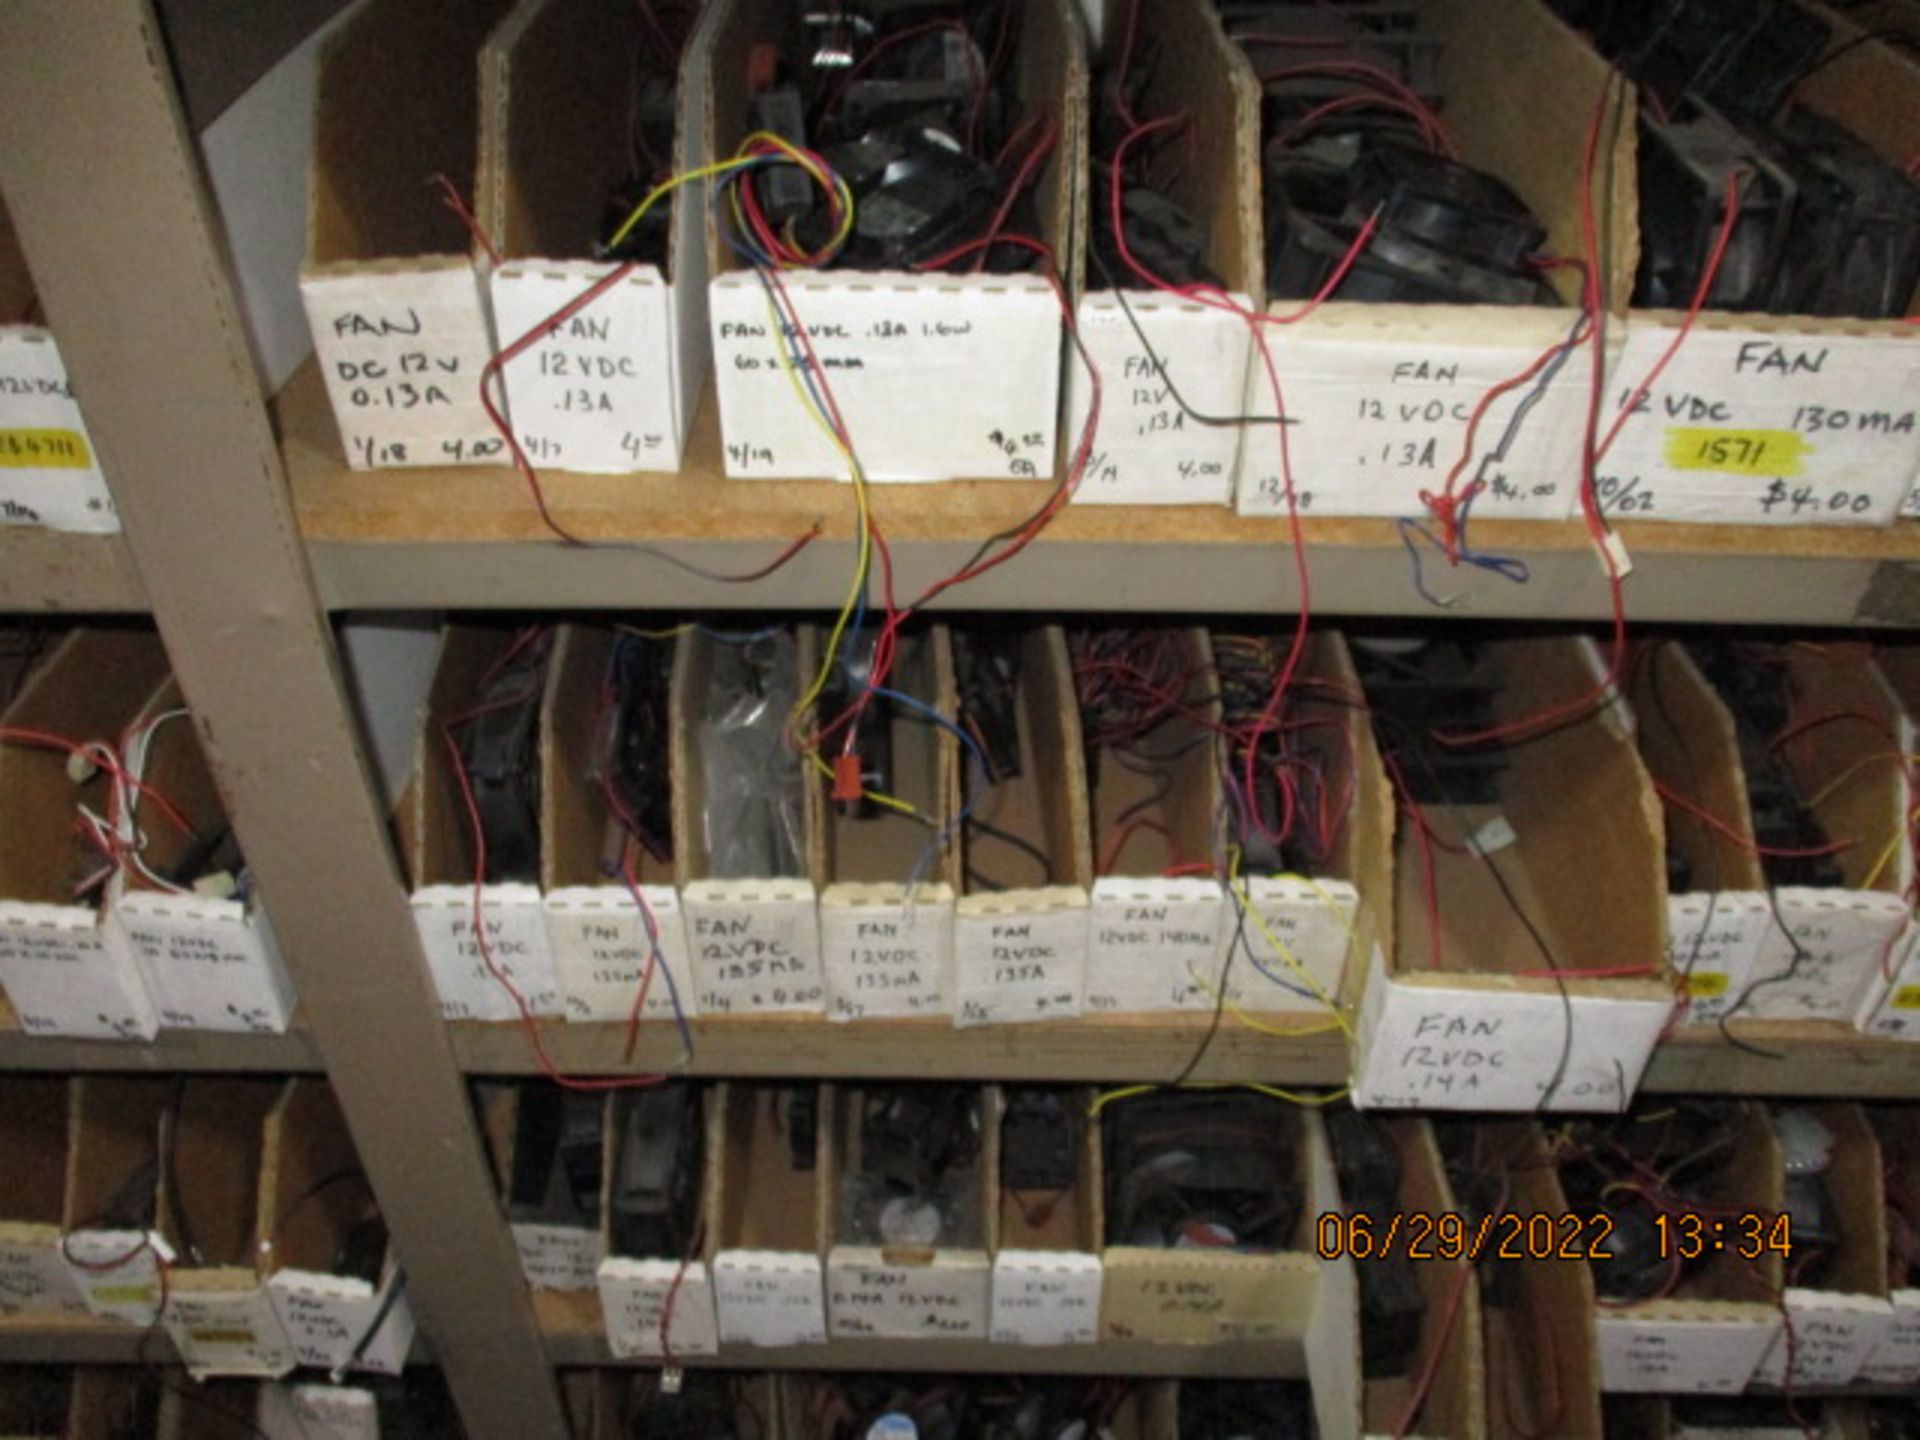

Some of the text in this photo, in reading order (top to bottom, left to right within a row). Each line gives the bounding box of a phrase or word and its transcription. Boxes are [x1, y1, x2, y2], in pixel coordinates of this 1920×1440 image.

[332, 307, 422, 338] FAN
[720, 322, 767, 338] FAN
[1124, 356, 1168, 379] FAN
[1735, 340, 1828, 376] FAN
[336, 361, 387, 380] DC
[1391, 361, 1459, 383] FAN
[350, 385, 453, 406] 0.13A
[553, 389, 613, 413] .13A
[1133, 389, 1169, 406] 12V
[1139, 412, 1185, 435] .13A
[442, 438, 505, 461] 4.00
[1699, 437, 1767, 467] 1571
[1759, 478, 1872, 513] $4.00
[695, 914, 753, 936] FAN
[1124, 906, 1169, 922] FAN
[857, 922, 898, 939] FAN
[992, 924, 1031, 940] FAN
[1415, 1012, 1504, 1037] FAN
